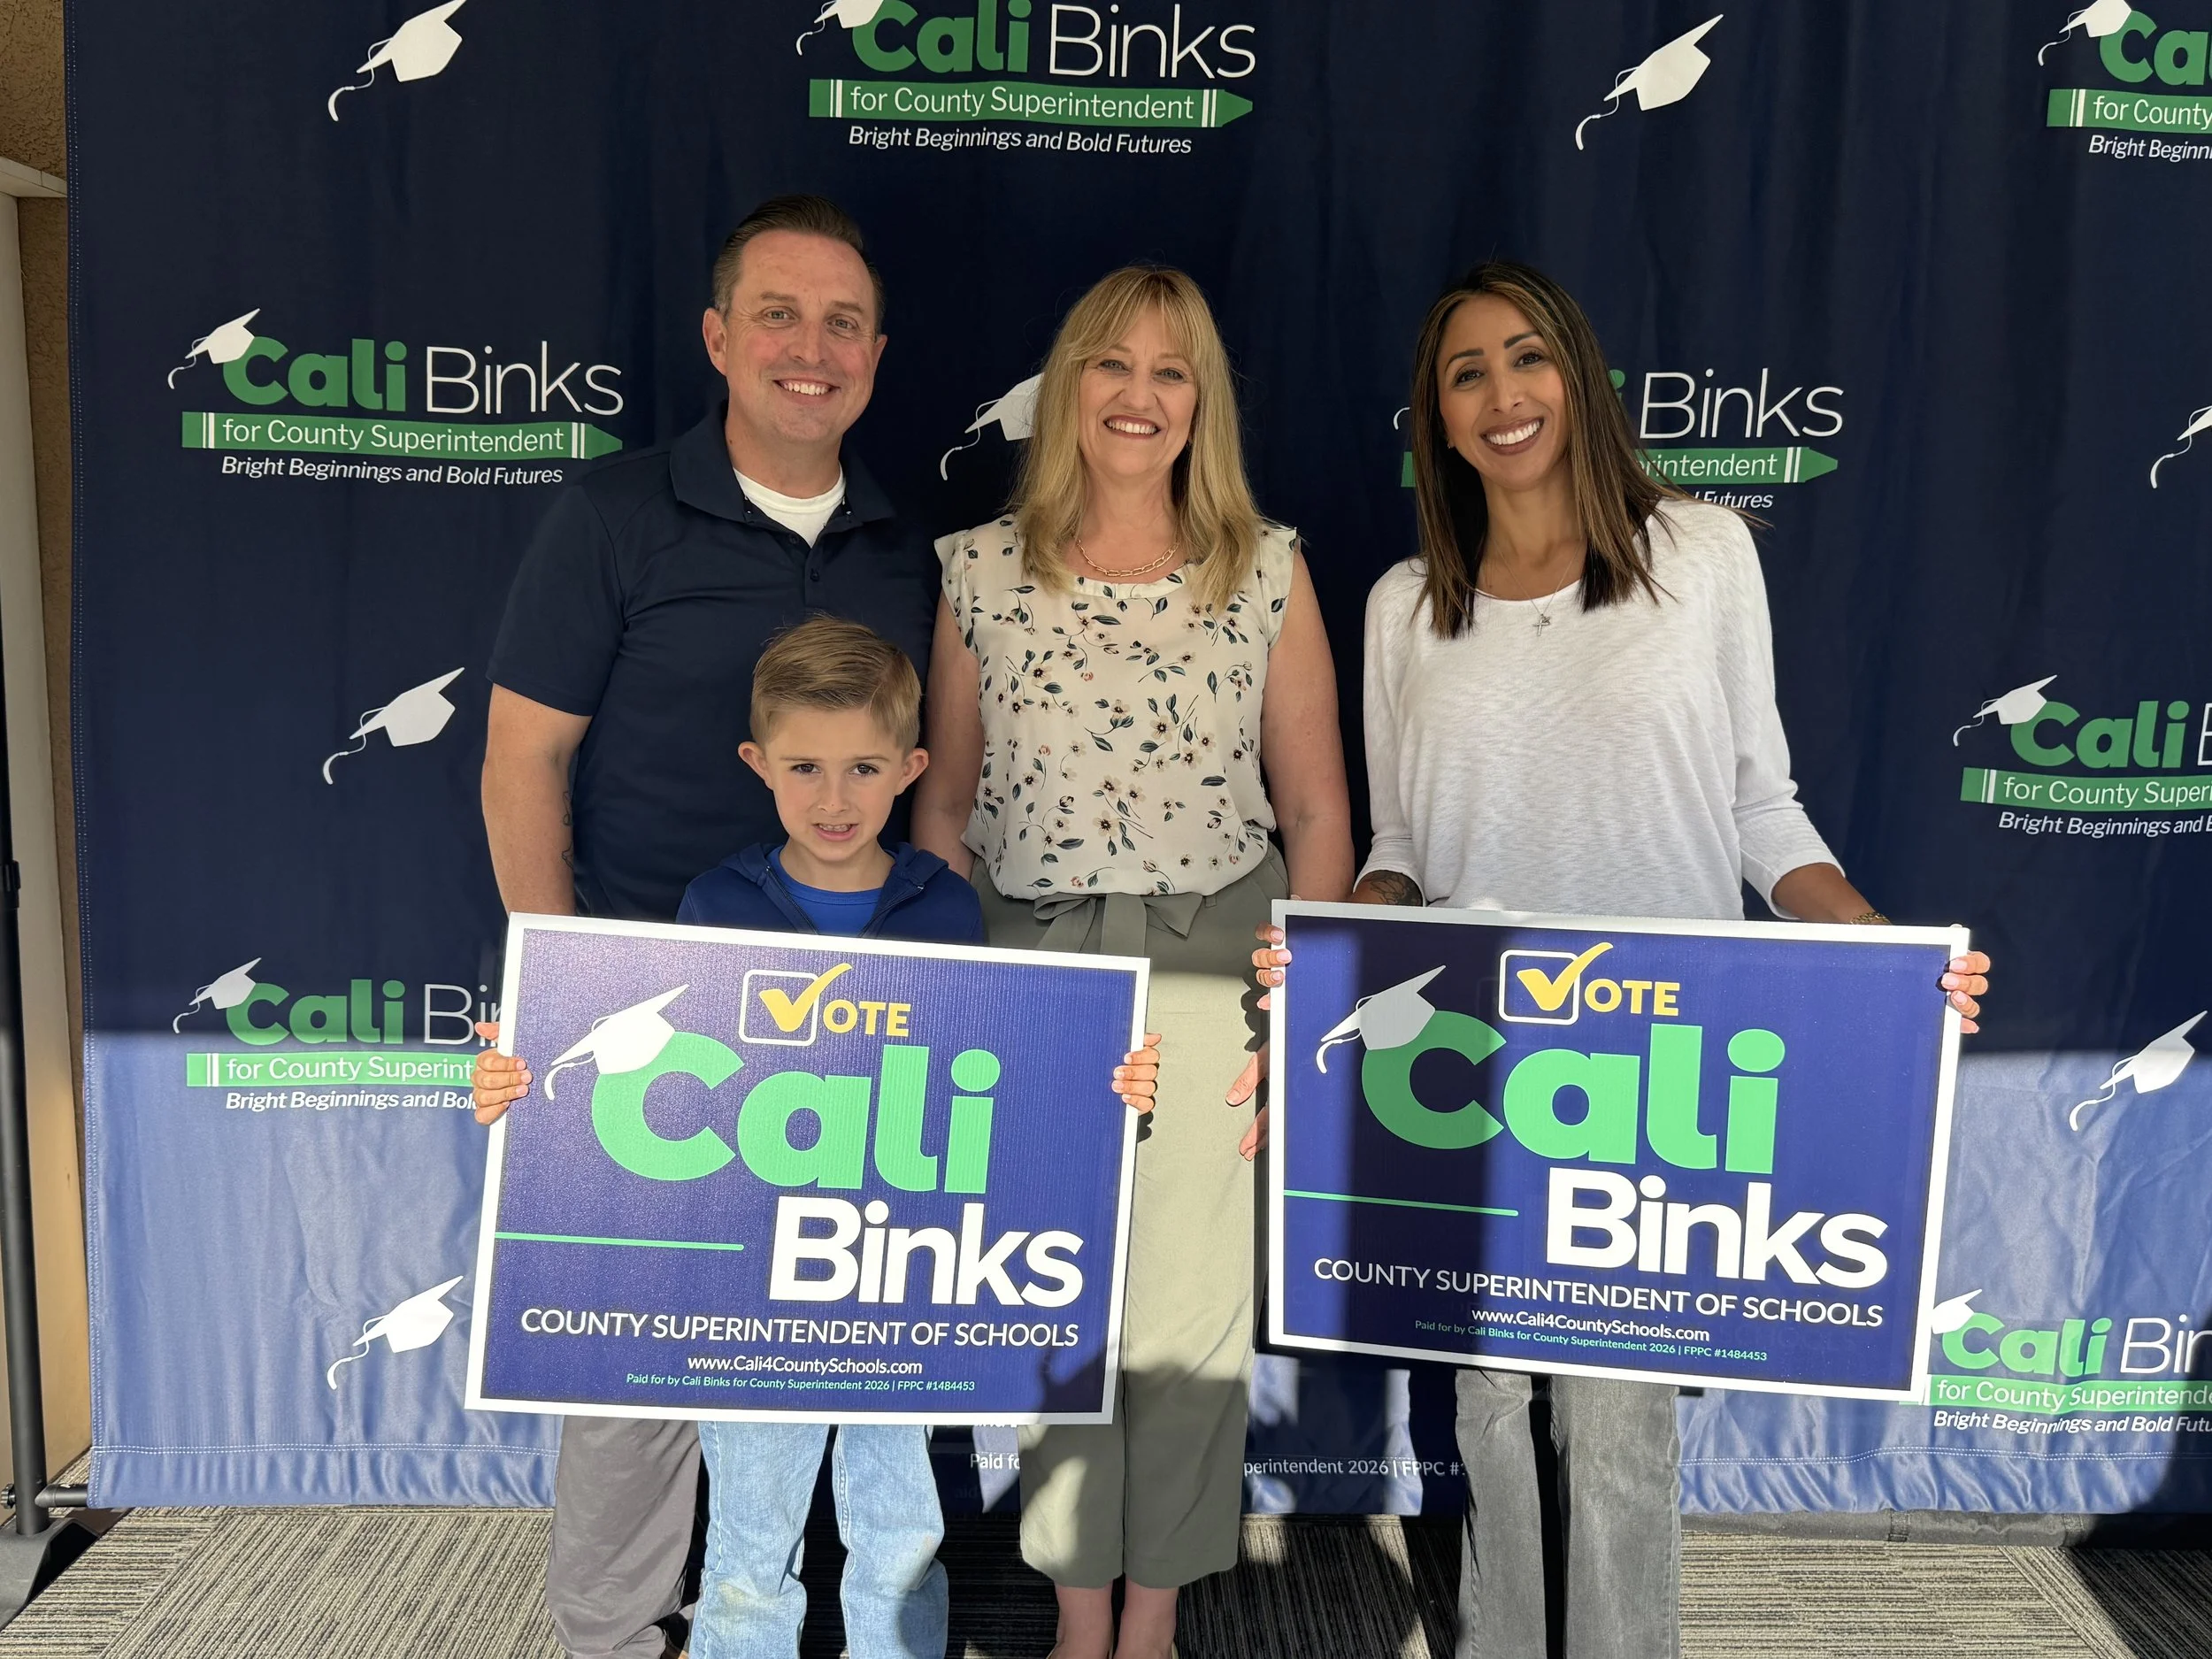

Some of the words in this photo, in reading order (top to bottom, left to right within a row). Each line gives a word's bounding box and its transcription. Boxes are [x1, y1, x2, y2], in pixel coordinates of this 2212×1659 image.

[852, 0, 1032, 73] Cali
[1048, 4, 1256, 79] Binks
[2099, 10, 2212, 86] Ca
[850, 86, 887, 112] for
[894, 87, 983, 117] County
[990, 87, 1194, 119] Superintendent
[2093, 95, 2129, 121] for
[849, 126, 911, 150] Bright
[916, 128, 1022, 152] Beginnings
[1025, 132, 1061, 150] and
[1066, 131, 1111, 152] Bold
[1116, 133, 1192, 154] Futures
[2088, 134, 2147, 159] Bright
[2148, 138, 2212, 163] Beginn
[223, 336, 408, 412] Cali
[426, 341, 623, 415] Binks
[1640, 367, 1844, 440] Binks
[222, 419, 261, 442] for
[266, 419, 365, 450] County
[370, 424, 565, 453] Superintendent
[221, 456, 285, 479] Bright
[288, 457, 403, 482] Beginnings
[406, 465, 442, 484] and
[446, 465, 489, 484] Bold
[493, 466, 564, 485] Futures
[1639, 453, 1778, 478] rintendent
[2010, 700, 2190, 769] Cali
[2003, 777, 2043, 801] for
[2048, 780, 2139, 809] County
[1999, 810, 2063, 834] Bright
[2067, 817, 2171, 839] Beginnings
[2173, 815, 2204, 833] and
[226, 979, 406, 1046] Cali
[227, 1058, 263, 1079] for
[269, 1058, 362, 1083] County
[226, 1091, 288, 1113] Bright
[290, 1089, 399, 1112] Beginnings
[402, 1090, 440, 1109] and
[1361, 1010, 1786, 1175] Cali
[591, 1031, 1002, 1194] Cali
[1546, 1167, 1889, 1289] Binks
[768, 1195, 1085, 1308] Binks
[1314, 1257, 1431, 1289] COUNTY
[1436, 1269, 1691, 1313] SUPERINTENDENT
[1695, 1293, 1738, 1317] OF
[1742, 1295, 1884, 1327] SCHOOLS
[521, 1308, 649, 1338] COUNTY
[651, 1315, 907, 1346] SUPERINTENDENT
[910, 1322, 949, 1346] OF
[954, 1323, 1079, 1347] SCHOOLS
[1416, 1320, 1435, 1331] Paid
[1438, 1322, 1452, 1333] for
[1454, 1324, 1465, 1335] by
[1468, 1325, 1486, 1337] Cali
[1488, 1328, 1515, 1339] Binks
[1517, 1330, 1532, 1340] for
[1533, 1332, 1570, 1345] County
[1571, 1335, 1647, 1352] Superintendent
[1649, 1343, 1676, 1354] 2026
[1684, 1346, 1711, 1356] FPPC
[1715, 1348, 1768, 1362] #1484453
[1471, 1310, 1710, 1341] www.Cali4CountySchools.com
[1942, 1312, 2113, 1378] Cali
[626, 1373, 648, 1384] Paid
[650, 1374, 665, 1385] for
[667, 1375, 680, 1386] by
[682, 1375, 701, 1386] Cali
[703, 1377, 730, 1387] Binks
[733, 1378, 748, 1387] for
[749, 1378, 786, 1390] County
[787, 1379, 862, 1390] Superintendent
[864, 1380, 890, 1391] 2026
[897, 1381, 924, 1391] FPPC
[926, 1381, 975, 1391] #1484453
[687, 1356, 923, 1376] www.Cali4CountySchools.com
[1937, 1379, 1970, 1401] for
[1976, 1381, 2066, 1413] County
[1934, 1410, 1990, 1431] Bright
[1993, 1413, 2093, 1435] Beginnings
[2094, 1417, 2131, 1432] and
[2131, 1416, 2174, 1433] Bold
[971, 1453, 1002, 1469] Paid
[1348, 1460, 1389, 1476] 2026
[1402, 1460, 1445, 1477] FPPC
